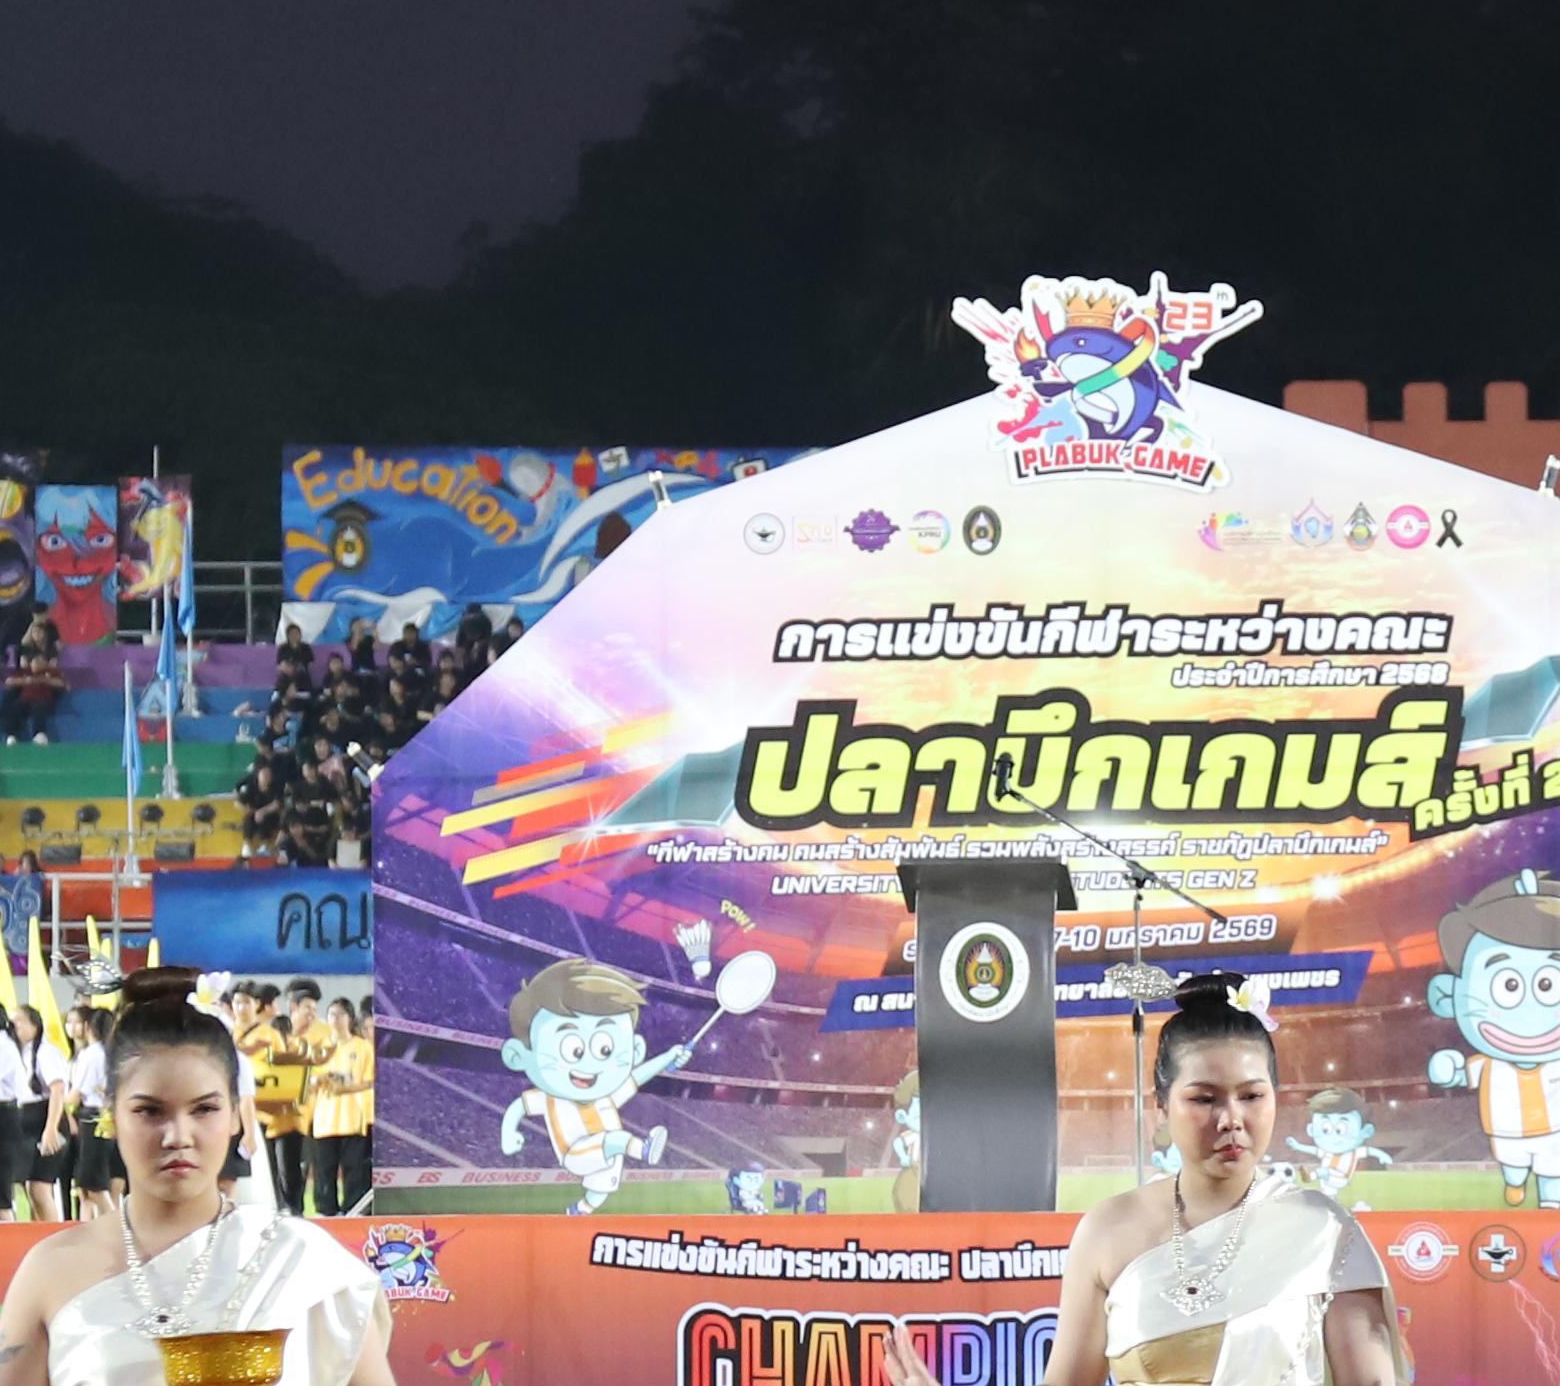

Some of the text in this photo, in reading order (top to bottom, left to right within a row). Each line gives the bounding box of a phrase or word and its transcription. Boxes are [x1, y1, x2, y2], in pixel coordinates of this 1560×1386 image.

[1165, 301, 1213, 330] 23
[780, 604, 1447, 660] การแข่งขันกีฬาระหว่างคณะ
[1172, 661, 1377, 689] ประจำปีการศึกษา
[748, 699, 1448, 816] ปลาบึกเกมส์
[1188, 870, 1237, 889] GEN
[1238, 869, 1258, 889] Z
[277, 891, 371, 951] คณ
[1210, 917, 1275, 942] 2569
[462, 1171, 541, 1184] BUSINESS
[594, 1233, 950, 1281] การแข่งขันกีฬาระหว่างคณะ
